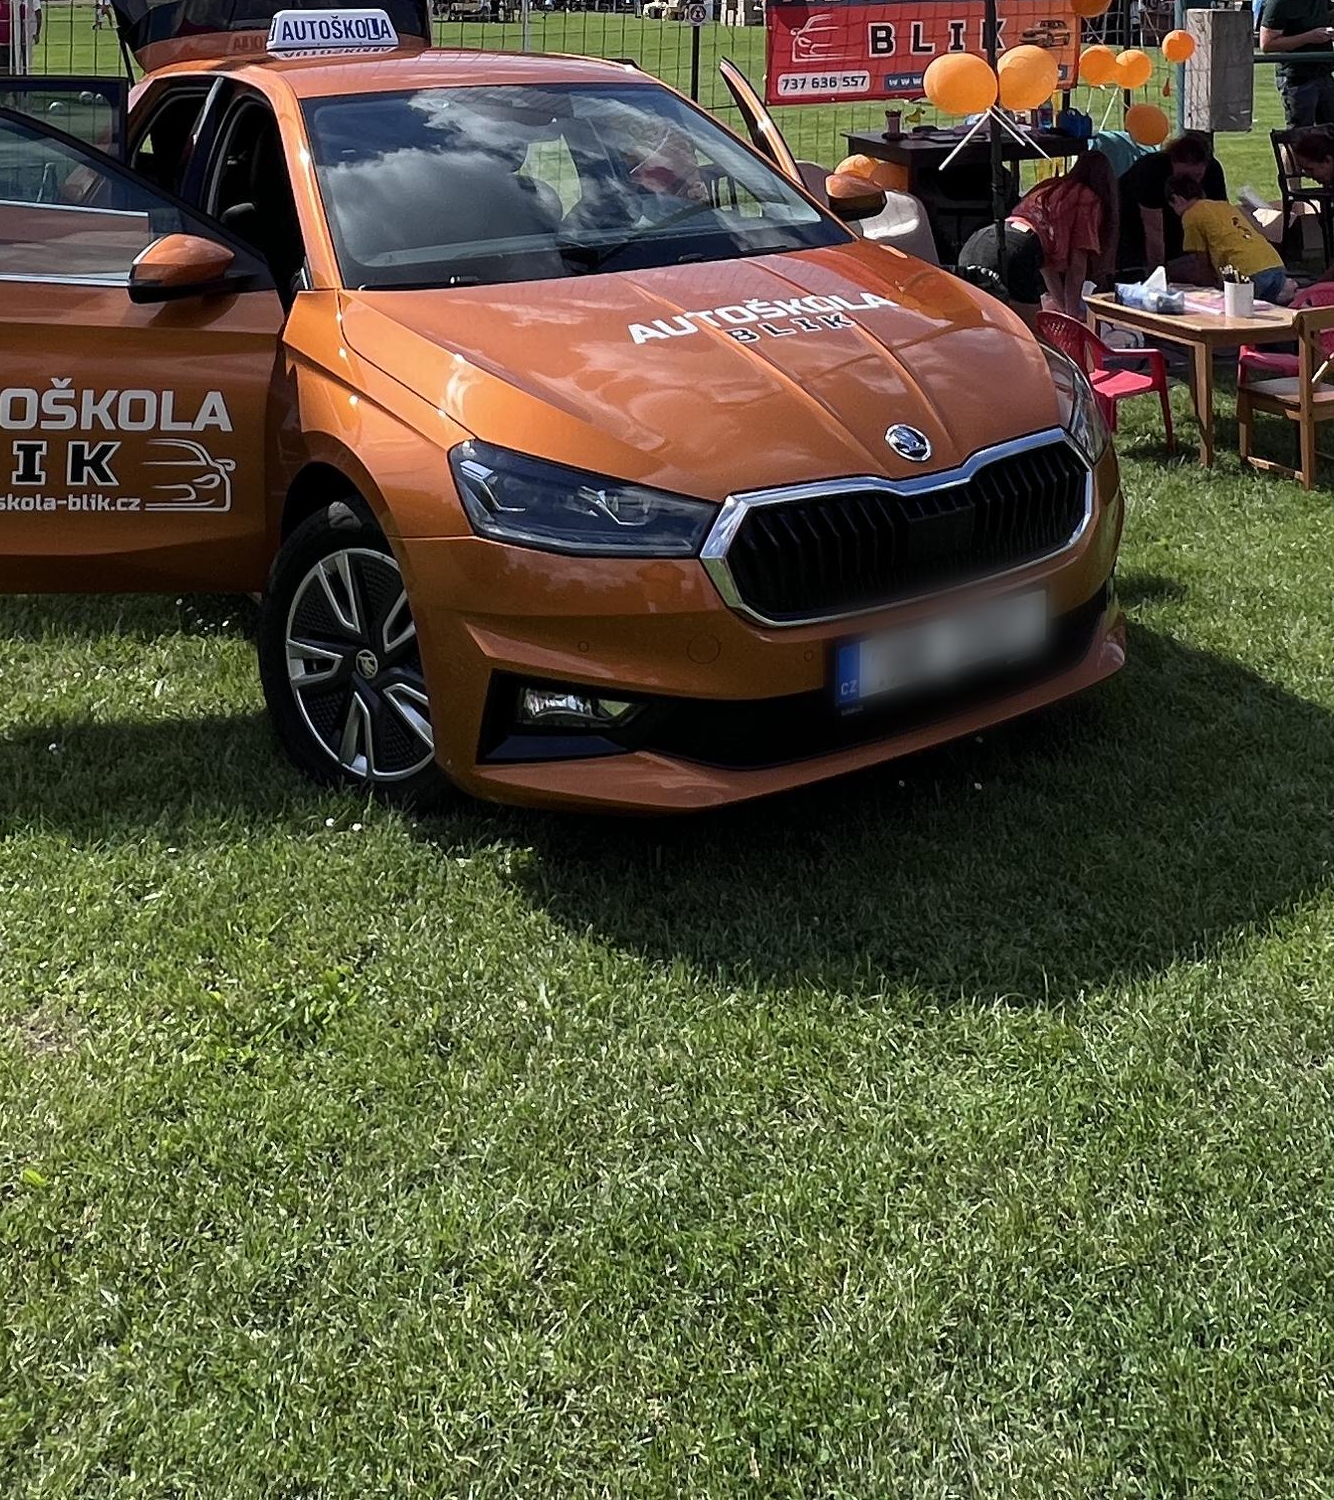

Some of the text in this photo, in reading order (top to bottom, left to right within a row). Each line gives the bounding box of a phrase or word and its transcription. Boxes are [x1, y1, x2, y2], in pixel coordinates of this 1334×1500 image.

[282, 15, 392, 41] AUTOŠKOLA
[868, 19, 1008, 57] BLIK
[782, 75, 867, 91] 737 636 557
[627, 290, 900, 345] AUTOŠKOLA
[723, 311, 858, 344] BLIK
[840, 679, 858, 696] CZ
